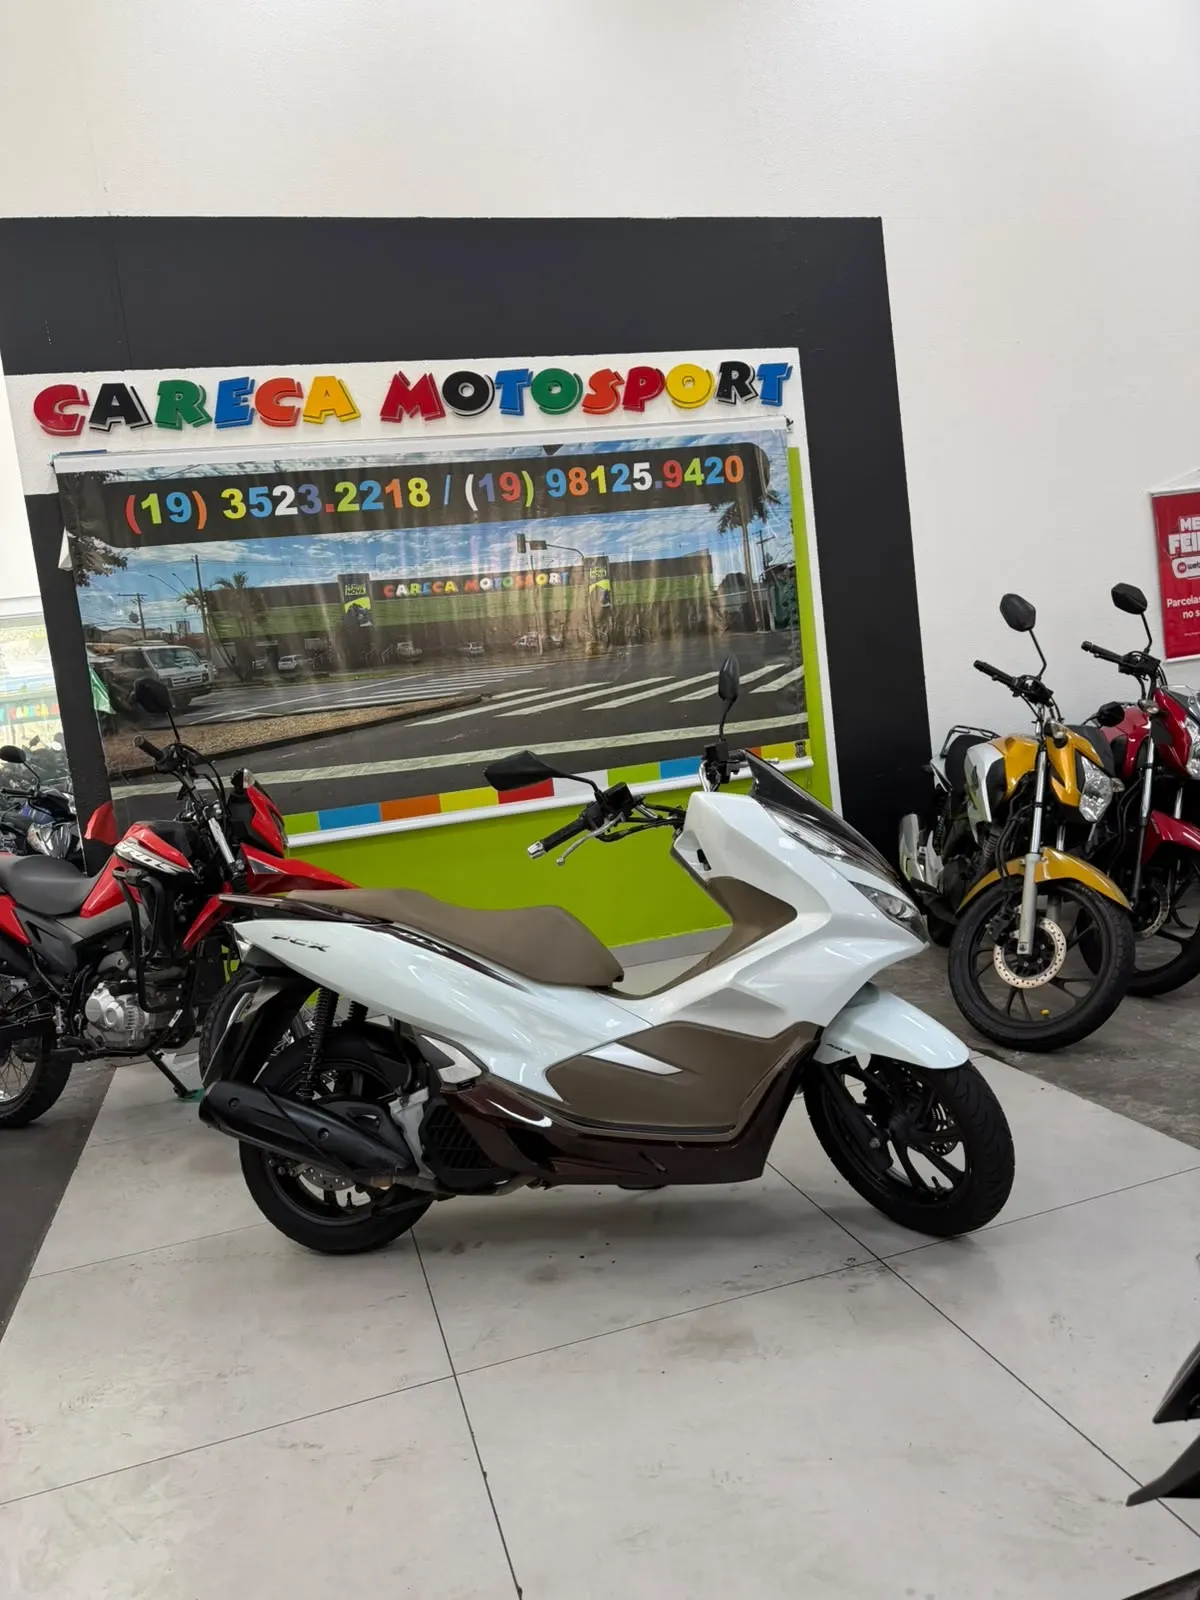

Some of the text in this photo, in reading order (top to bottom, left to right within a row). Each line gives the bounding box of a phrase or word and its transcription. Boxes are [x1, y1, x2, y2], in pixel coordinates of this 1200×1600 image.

[33, 360, 793, 437] CARECA MOTOSPORT
[125, 454, 744, 535] (19) 3523.2218 / (19) 98125.9420
[383, 580, 459, 598] CARECA
[1166, 595, 1200, 608] Parcela
[1182, 610, 1194, 619] no
